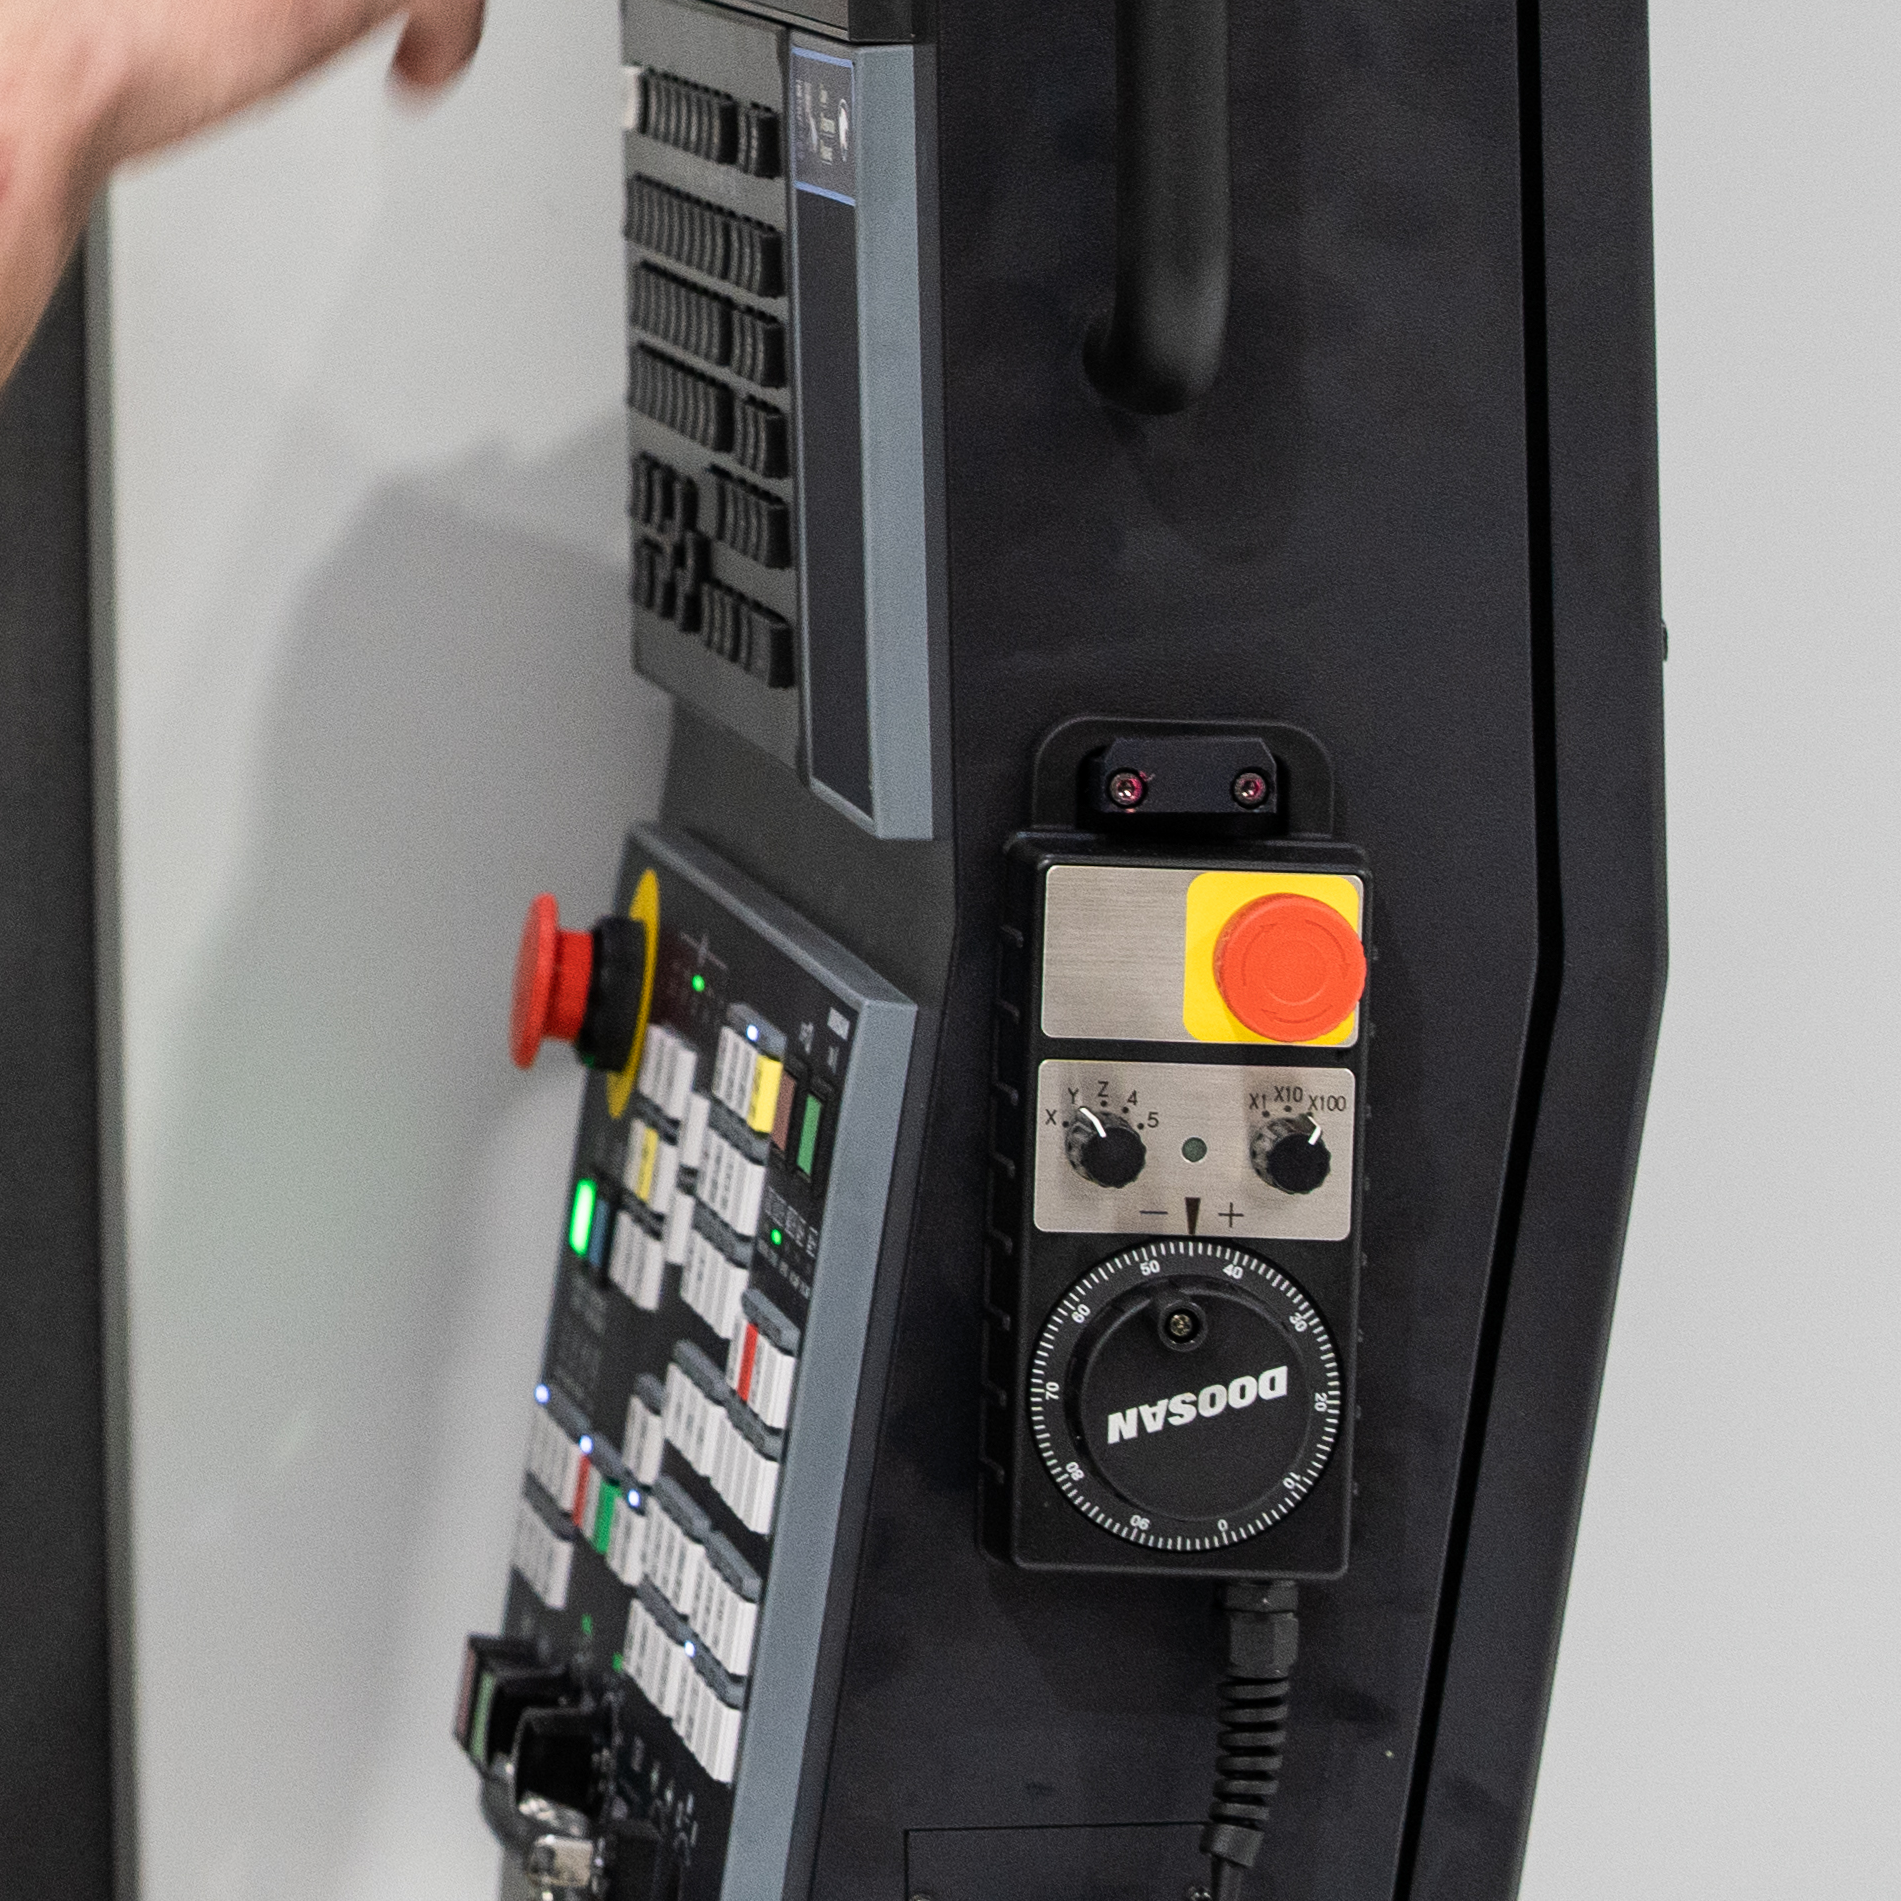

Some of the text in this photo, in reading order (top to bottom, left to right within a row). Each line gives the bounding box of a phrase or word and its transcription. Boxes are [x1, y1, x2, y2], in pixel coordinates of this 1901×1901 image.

[1045, 1081, 1159, 1128] X Y Z 4 5
[1249, 1086, 1346, 1112] X1 X10 X100
[1140, 1259, 1160, 1276] 50
[1222, 1263, 1244, 1280] 40
[1071, 1303, 1091, 1324] 60
[1288, 1311, 1308, 1333] 30
[1045, 1381, 1060, 1401] 70
[1107, 1365, 1288, 1445] DOOSAN
[1314, 1392, 1328, 1413] 20
[1065, 1461, 1085, 1481] 80
[1282, 1471, 1301, 1489] 10
[1129, 1514, 1151, 1530] 90
[1217, 1518, 1228, 1532] 0
